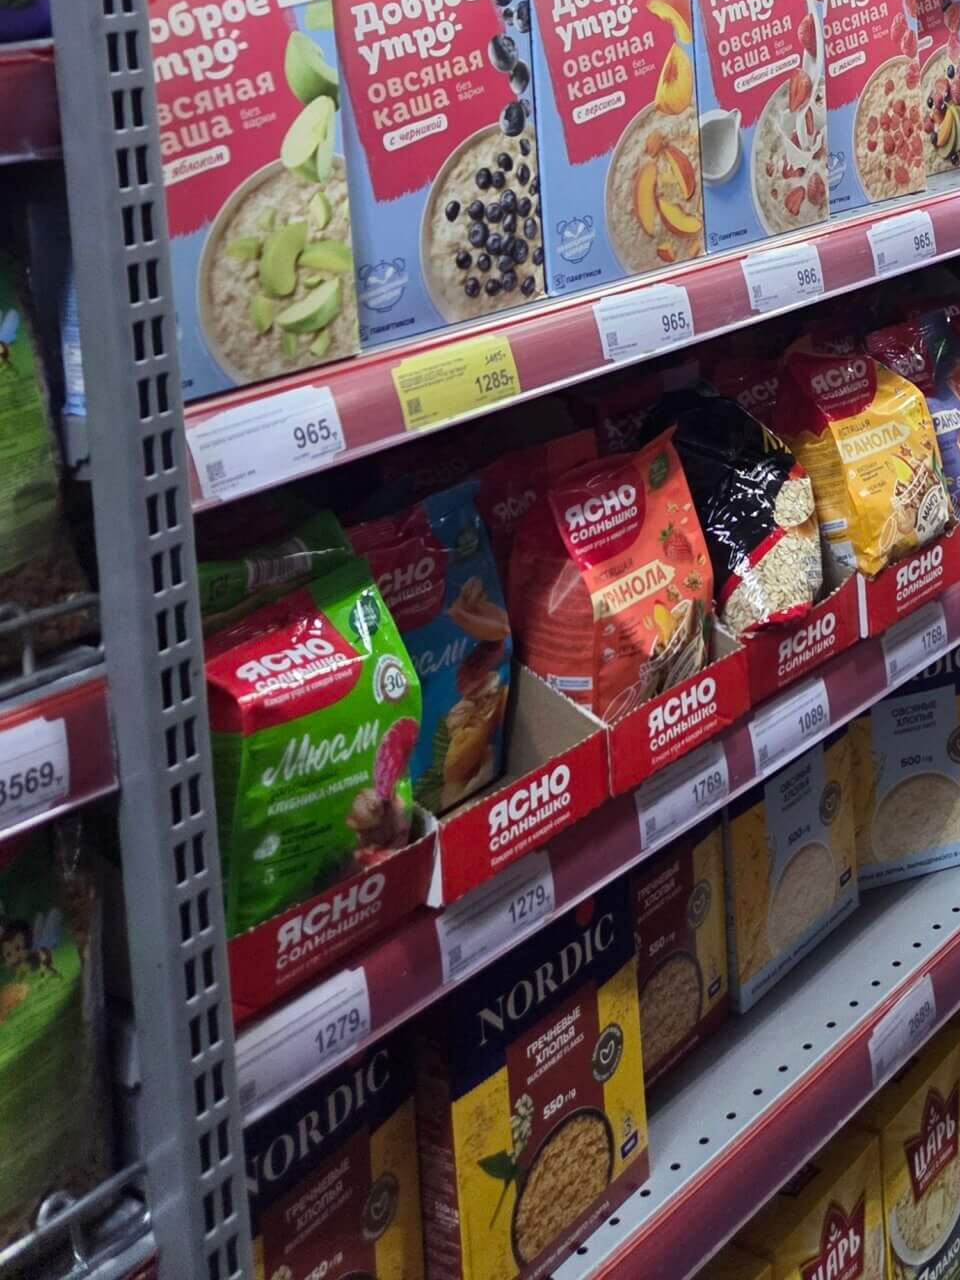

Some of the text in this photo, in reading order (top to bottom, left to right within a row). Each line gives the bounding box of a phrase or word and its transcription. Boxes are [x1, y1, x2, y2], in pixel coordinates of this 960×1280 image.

[554, 8, 634, 53] утро
[718, 15, 793, 57] овсяная
[823, 2, 888, 40] овсяная
[357, 22, 457, 75] утро
[562, 32, 656, 79] овсяная
[631, 57, 646, 70] без
[722, 45, 771, 78] каша
[825, 29, 869, 59] каша
[366, 49, 485, 106] овсяная
[455, 80, 473, 94] без
[567, 64, 628, 102] каша
[633, 62, 657, 78] варки
[240, 106, 261, 119] без
[372, 85, 450, 131] каша
[457, 85, 485, 104] варки
[584, 95, 623, 116] персиком
[399, 118, 444, 144] черникой
[171, 152, 225, 176] яблоком
[811, 358, 867, 394] ЯСНО
[565, 484, 637, 532] ЯСНО
[570, 506, 638, 544] СОЛНЫШКО
[921, 496, 939, 521] МАНГО
[896, 545, 944, 590] ЯСНО
[896, 564, 944, 602] СОЛНЫШКО
[778, 611, 836, 664] ЯСНО
[778, 634, 837, 677] СОЛНЫШКО
[236, 637, 336, 682] ЯСНО
[254, 652, 348, 694] СОЛНЫШКО
[388, 672, 405, 692] 30
[648, 676, 717, 737] ЯСНО
[649, 701, 718, 753] СОЛНЫШКО
[261, 718, 380, 787] Мюсли
[900, 755, 921, 768] 500
[267, 770, 369, 817] КЛУБНИКА-МАЛИНА
[488, 764, 571, 837] ЯСНО
[489, 792, 571, 852] СОЛНЫШКО
[275, 871, 386, 955] ЯСНО
[275, 899, 384, 970] СОЛНЫШКО
[478, 913, 616, 1048] NORDIC
[526, 1005, 582, 1059] ГРЕЧНЕВЫЕ
[534, 1026, 577, 1067] ХЛОПЬЯ
[543, 1095, 566, 1120] 550
[914, 1114, 957, 1180] ЦАРЬ
